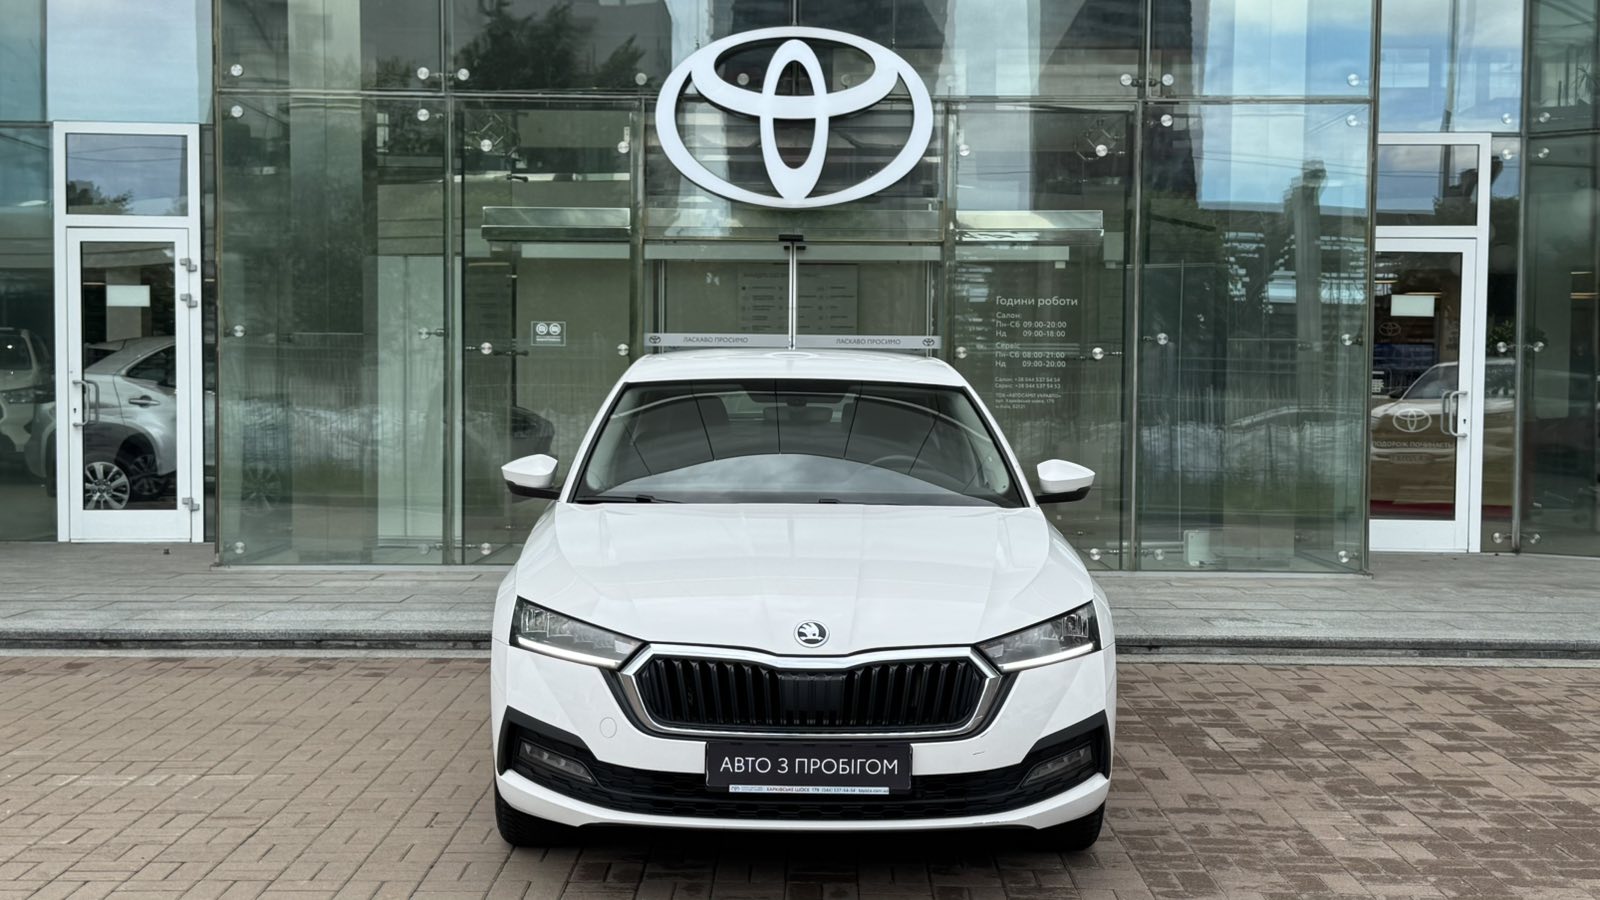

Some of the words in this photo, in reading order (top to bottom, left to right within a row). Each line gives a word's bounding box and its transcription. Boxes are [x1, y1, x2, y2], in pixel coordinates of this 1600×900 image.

[996, 296, 1035, 307] Години
[1037, 296, 1079, 308] роботи
[1022, 321, 1067, 329] 09:00-20:00
[996, 330, 1008, 338] Нд
[1022, 330, 1066, 338] 09:00-18:00
[683, 336, 714, 344] ЛАСКАВО
[714, 336, 749, 344] ПРОСИМО
[867, 338, 901, 346] ПРОСИМО
[995, 351, 1020, 359] Пн-Сб
[1022, 351, 1066, 359] 08:00-21:00
[995, 360, 1007, 368] Нд
[1022, 360, 1067, 368] 09:00-20:00
[720, 757, 771, 773] АВТО
[777, 758, 789, 773] З
[795, 758, 898, 775] ПРОБІГОМ
